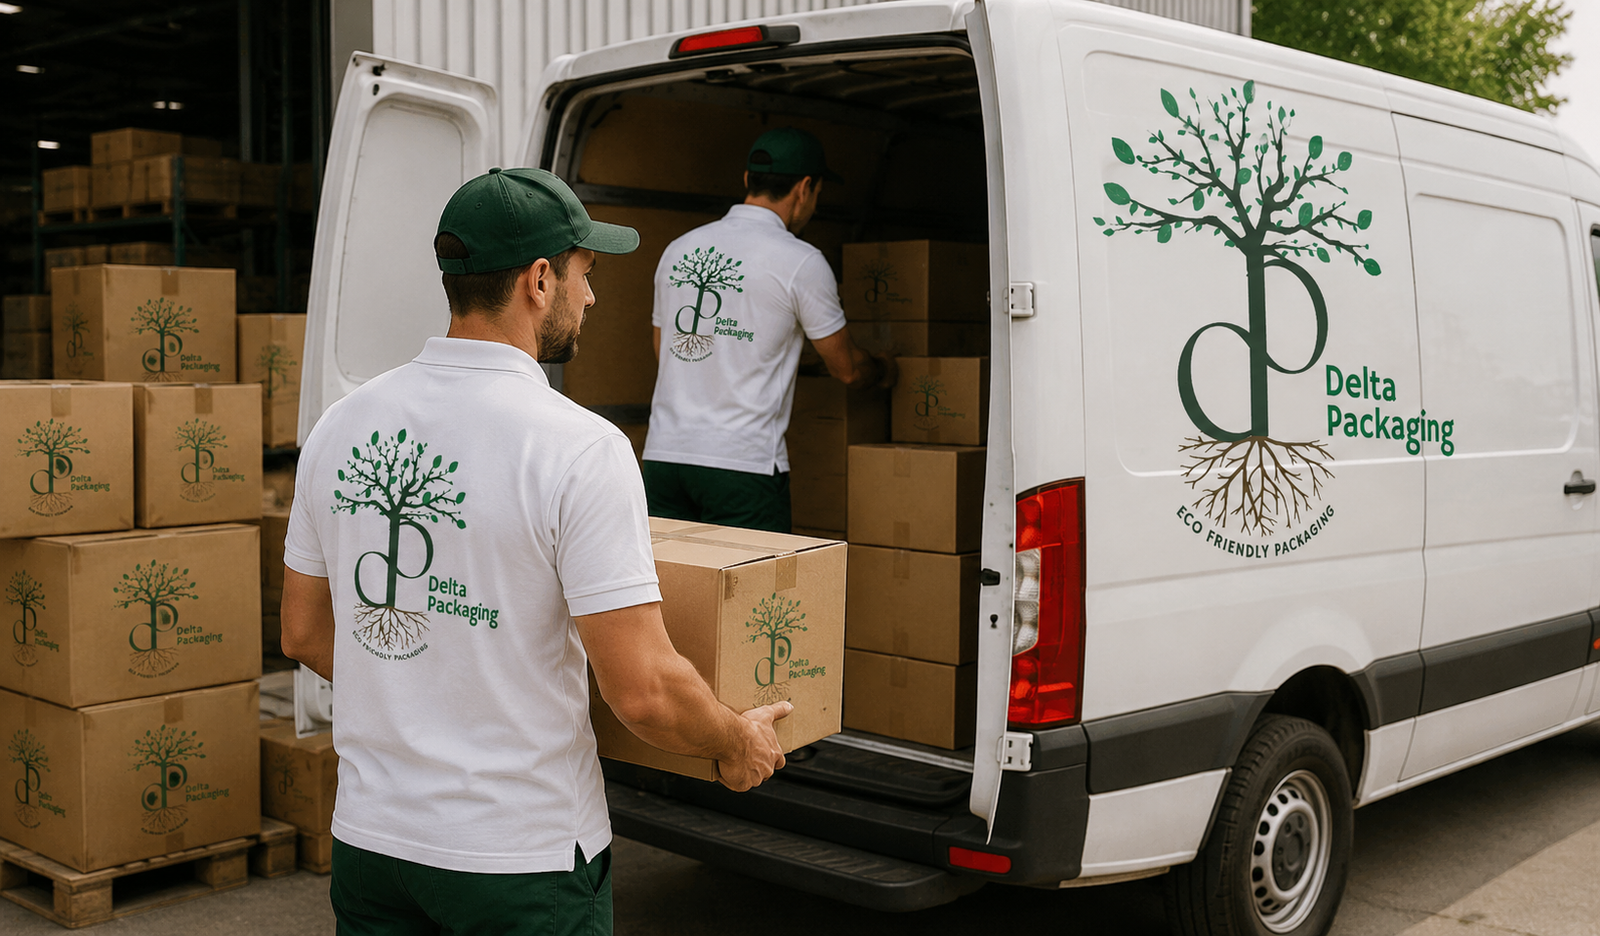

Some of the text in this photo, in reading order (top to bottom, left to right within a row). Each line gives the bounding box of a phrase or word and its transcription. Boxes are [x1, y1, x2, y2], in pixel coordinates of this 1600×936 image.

[715, 316, 738, 327] Delta
[714, 326, 755, 342] Packaging
[1325, 364, 1397, 402] Delta
[1327, 404, 1454, 457] Packaging
[70, 482, 111, 493] Packaging
[1176, 505, 1335, 559] ECO FRIENDLY PACKAGING
[428, 575, 467, 598] Delta
[427, 595, 499, 629] Packaging
[176, 625, 203, 636] Delta
[177, 632, 223, 646] Packaging
[394, 642, 429, 661] PACKAGING
[789, 658, 809, 669] Delta
